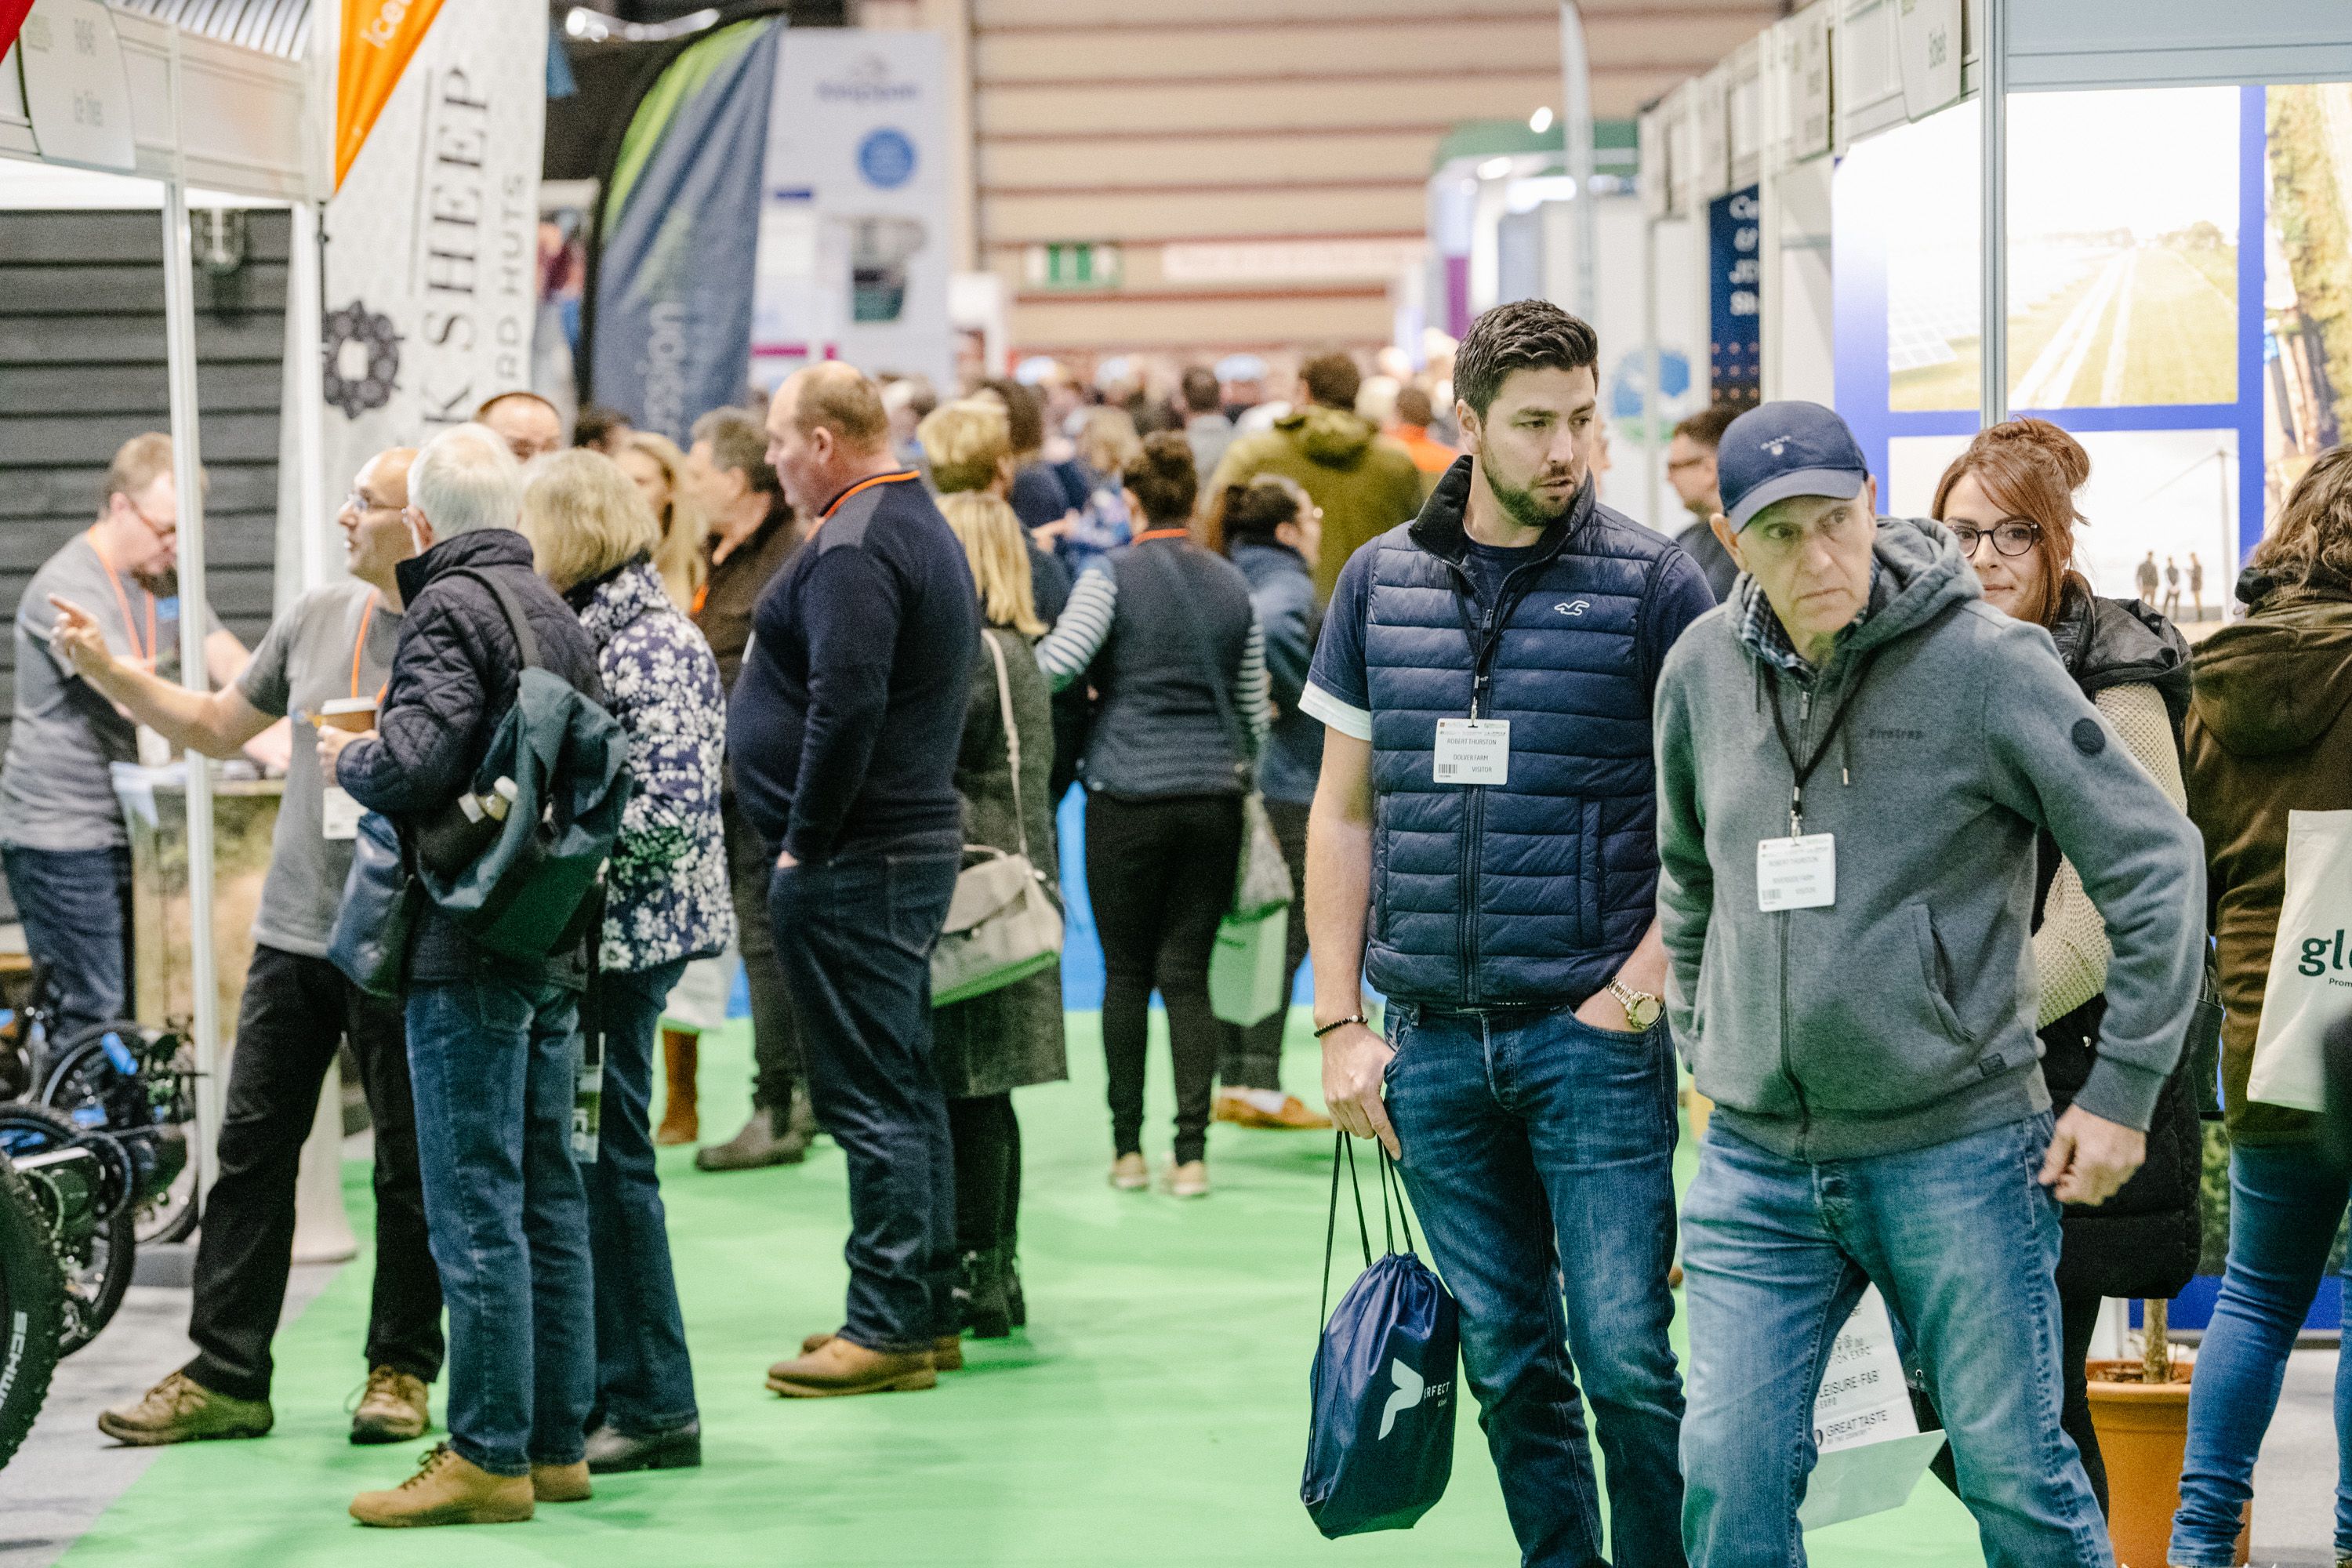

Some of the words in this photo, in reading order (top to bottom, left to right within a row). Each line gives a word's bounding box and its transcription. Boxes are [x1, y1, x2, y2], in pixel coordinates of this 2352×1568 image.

[426, 66, 488, 351] SHEEP
[501, 173, 528, 296] HUTS
[2298, 928, 2352, 977] gl
[1827, 1417, 1857, 1437] GREAT
[1858, 1410, 1888, 1425] TASTE
